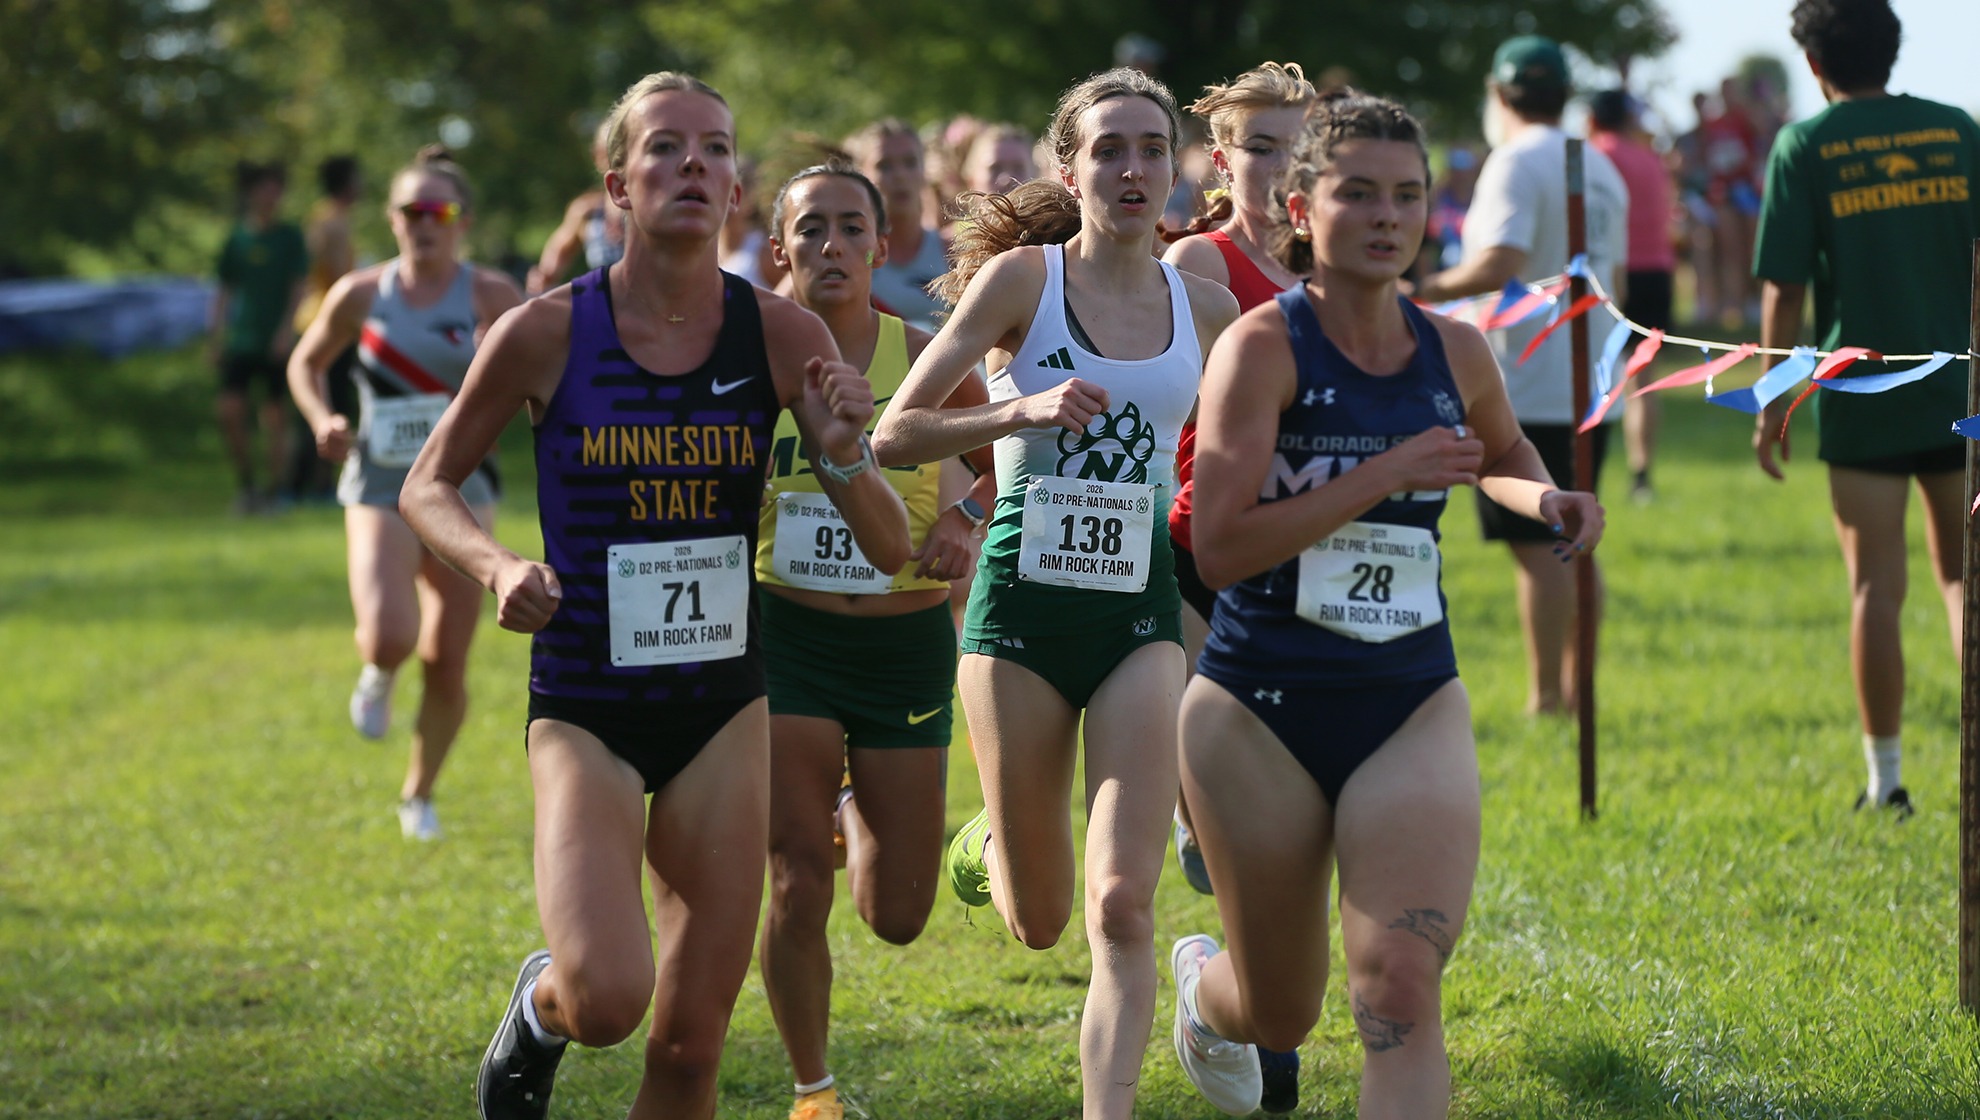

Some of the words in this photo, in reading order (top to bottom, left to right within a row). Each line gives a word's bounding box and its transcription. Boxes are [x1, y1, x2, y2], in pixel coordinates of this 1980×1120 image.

[1820, 140, 1850, 159] CAL
[1853, 135, 1891, 151] POLY
[1893, 128, 1960, 147] POMONA
[1830, 176, 1969, 218] BRONCOS
[582, 425, 756, 466] MINNESOTA
[1278, 435, 1386, 451] OLORADO
[629, 479, 719, 520] STATE
[1086, 484, 1104, 494] 2026
[801, 506, 811, 517] D2
[1052, 493, 1065, 505] D2
[1066, 494, 1133, 511] PRE-NATIONALS
[814, 526, 852, 561] 93
[1058, 514, 1123, 555] 138
[674, 546, 692, 556] 2026
[1332, 537, 1346, 552] D2
[1348, 539, 1416, 558] PRE-NATIONALS
[639, 561, 652, 575] D2
[654, 556, 722, 574] PRE-NATIONALS
[789, 560, 810, 576] RIM
[812, 563, 841, 579] ROCK
[844, 565, 875, 581] FARM
[1039, 553, 1062, 571] RIM
[1065, 556, 1099, 574] ROCK
[1101, 559, 1134, 577] FARM
[1347, 562, 1394, 604] 28
[662, 580, 705, 624] 71
[1320, 604, 1345, 623] RIM
[1348, 605, 1384, 626] ROCK
[1385, 608, 1422, 628] FARM
[634, 630, 659, 648] RIM
[663, 627, 698, 647] ROCK
[700, 623, 733, 643] FARM
